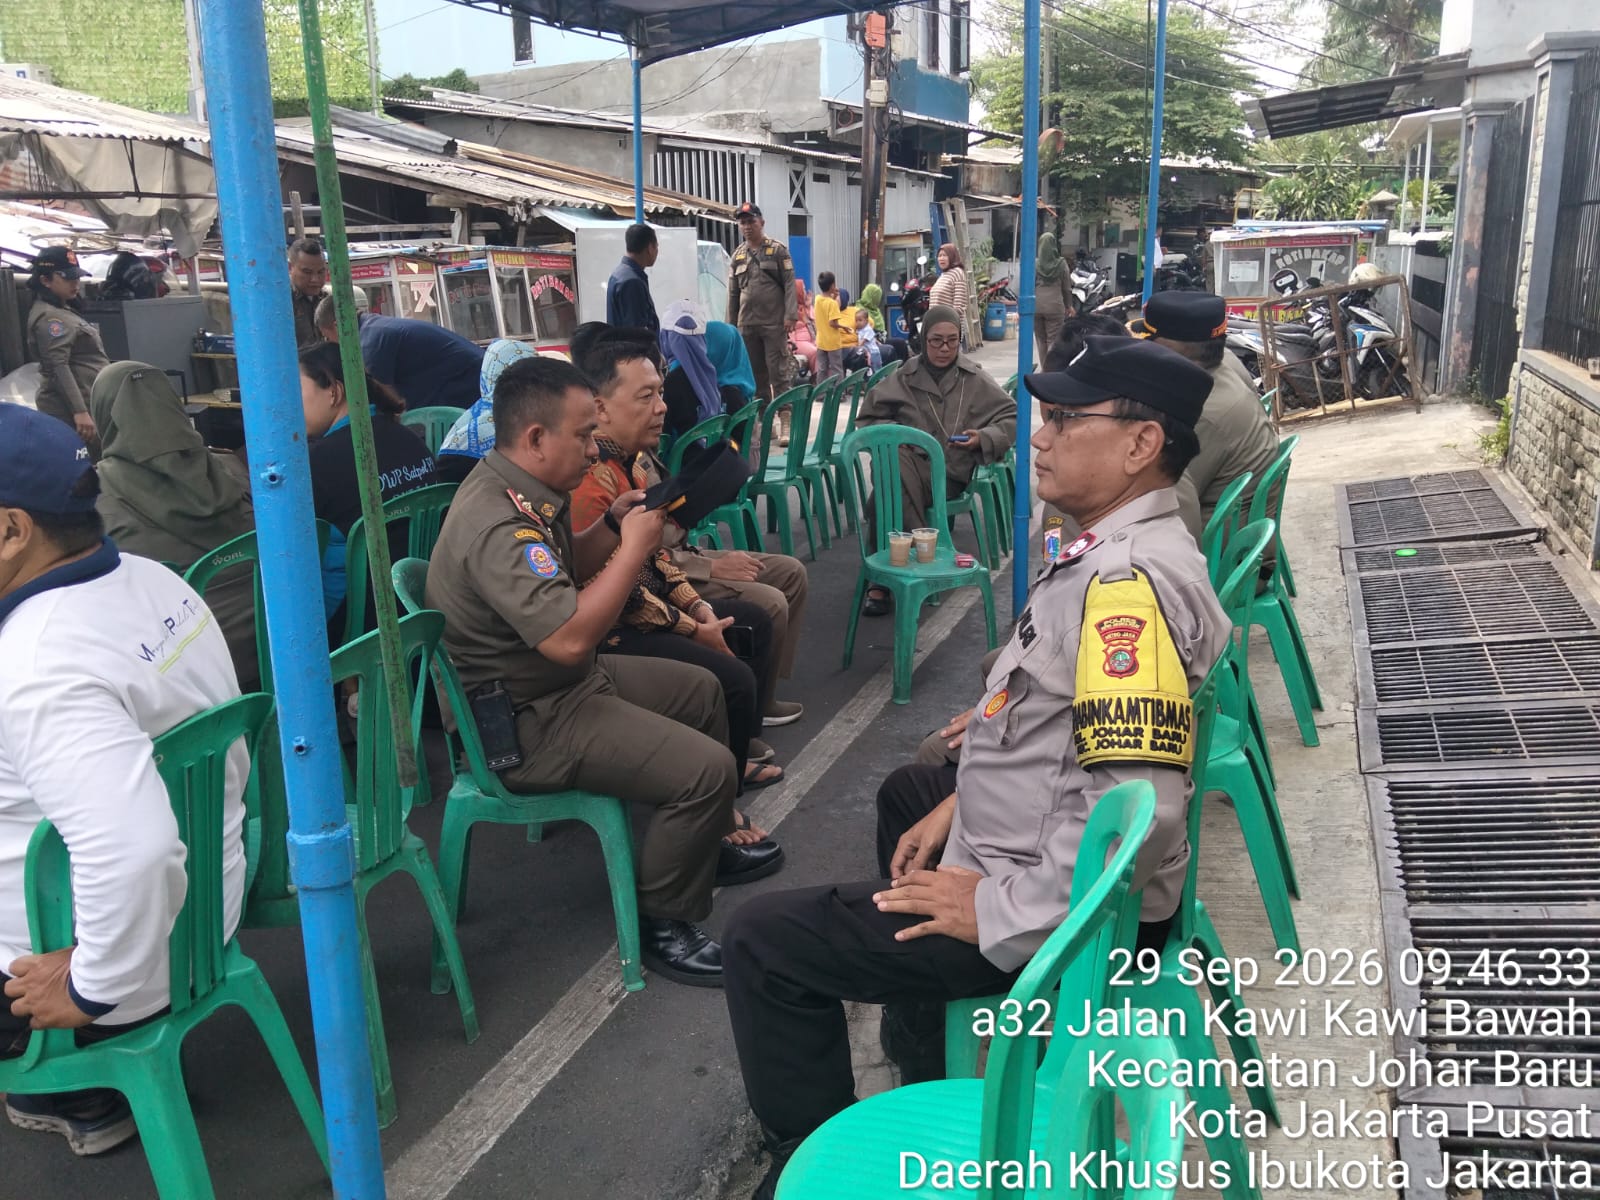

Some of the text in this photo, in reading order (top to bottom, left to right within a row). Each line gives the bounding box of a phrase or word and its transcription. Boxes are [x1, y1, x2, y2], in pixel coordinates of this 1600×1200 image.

[1090, 726, 1144, 740] JOHAR
[1152, 727, 1187, 745] BARU
[1094, 738, 1143, 750] JOHAR
[1149, 739, 1183, 755] BARU
